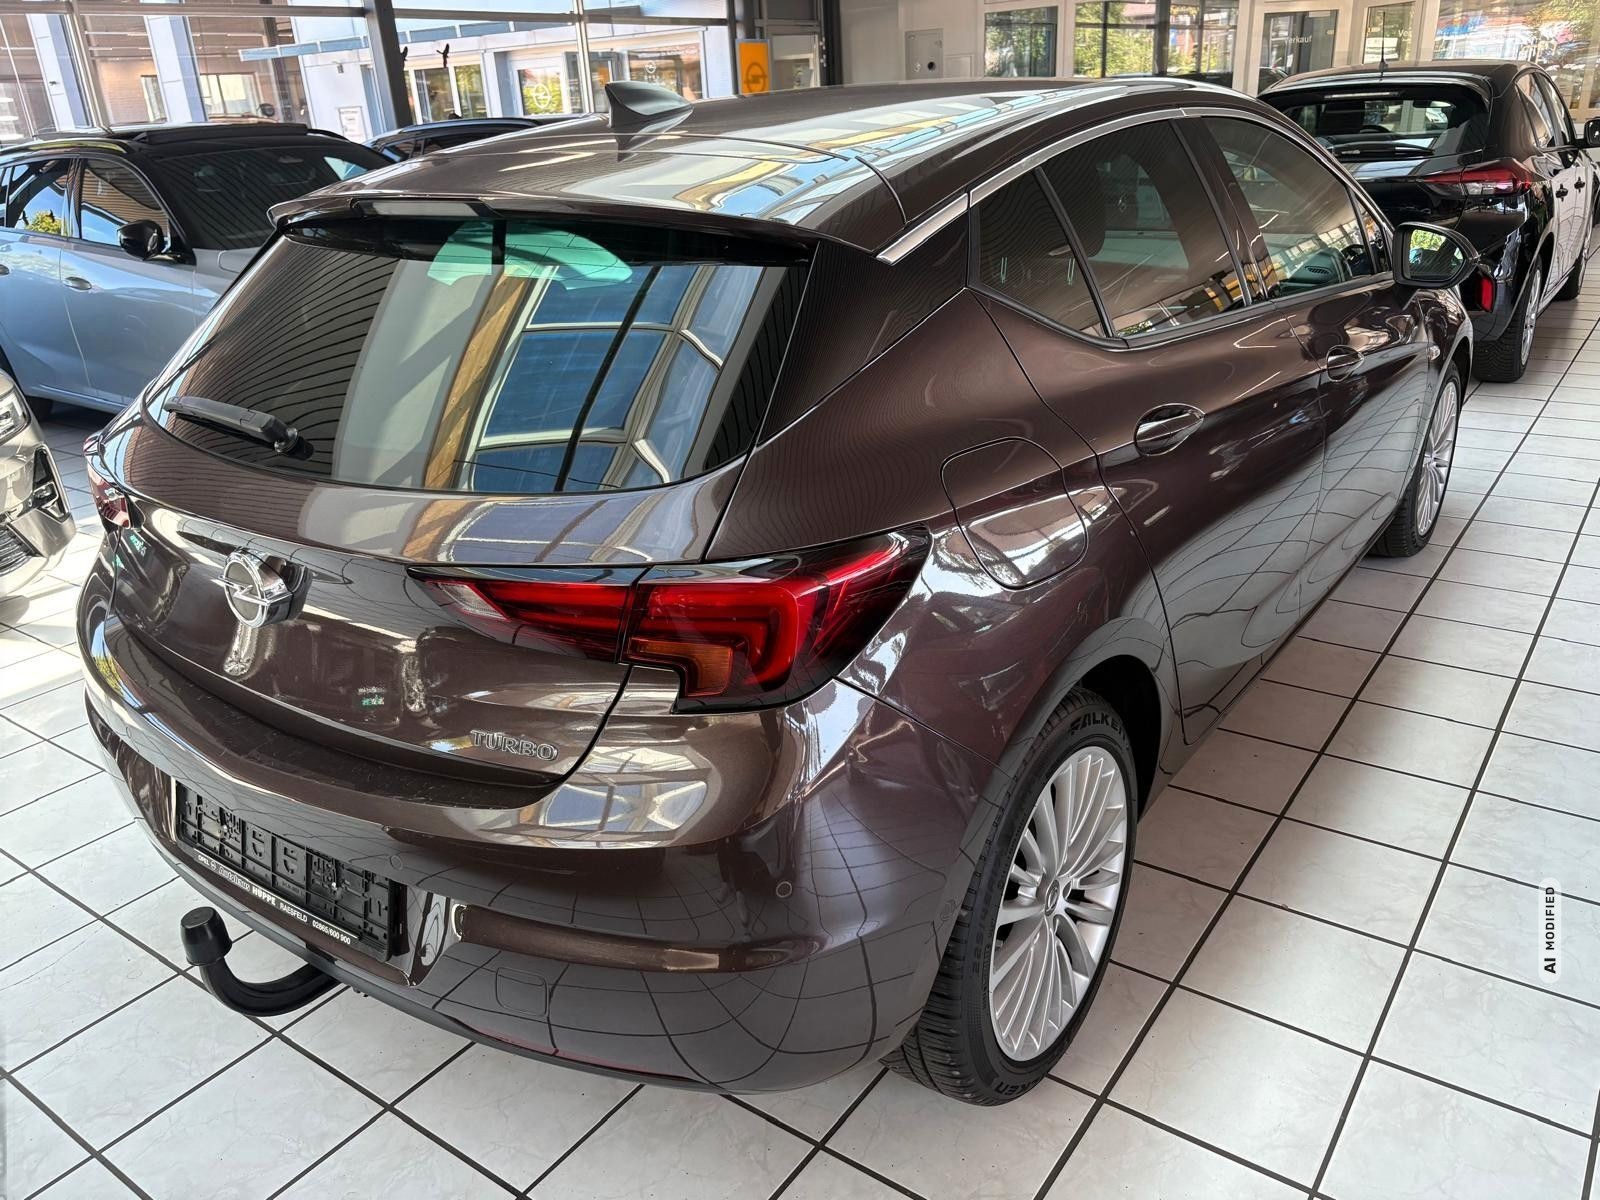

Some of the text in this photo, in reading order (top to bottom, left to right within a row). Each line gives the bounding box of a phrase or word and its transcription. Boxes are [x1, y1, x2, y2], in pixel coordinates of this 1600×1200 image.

[1070, 711, 1126, 740] FALKEN
[470, 730, 559, 761] TURBO
[279, 902, 308, 923] RAESFELD
